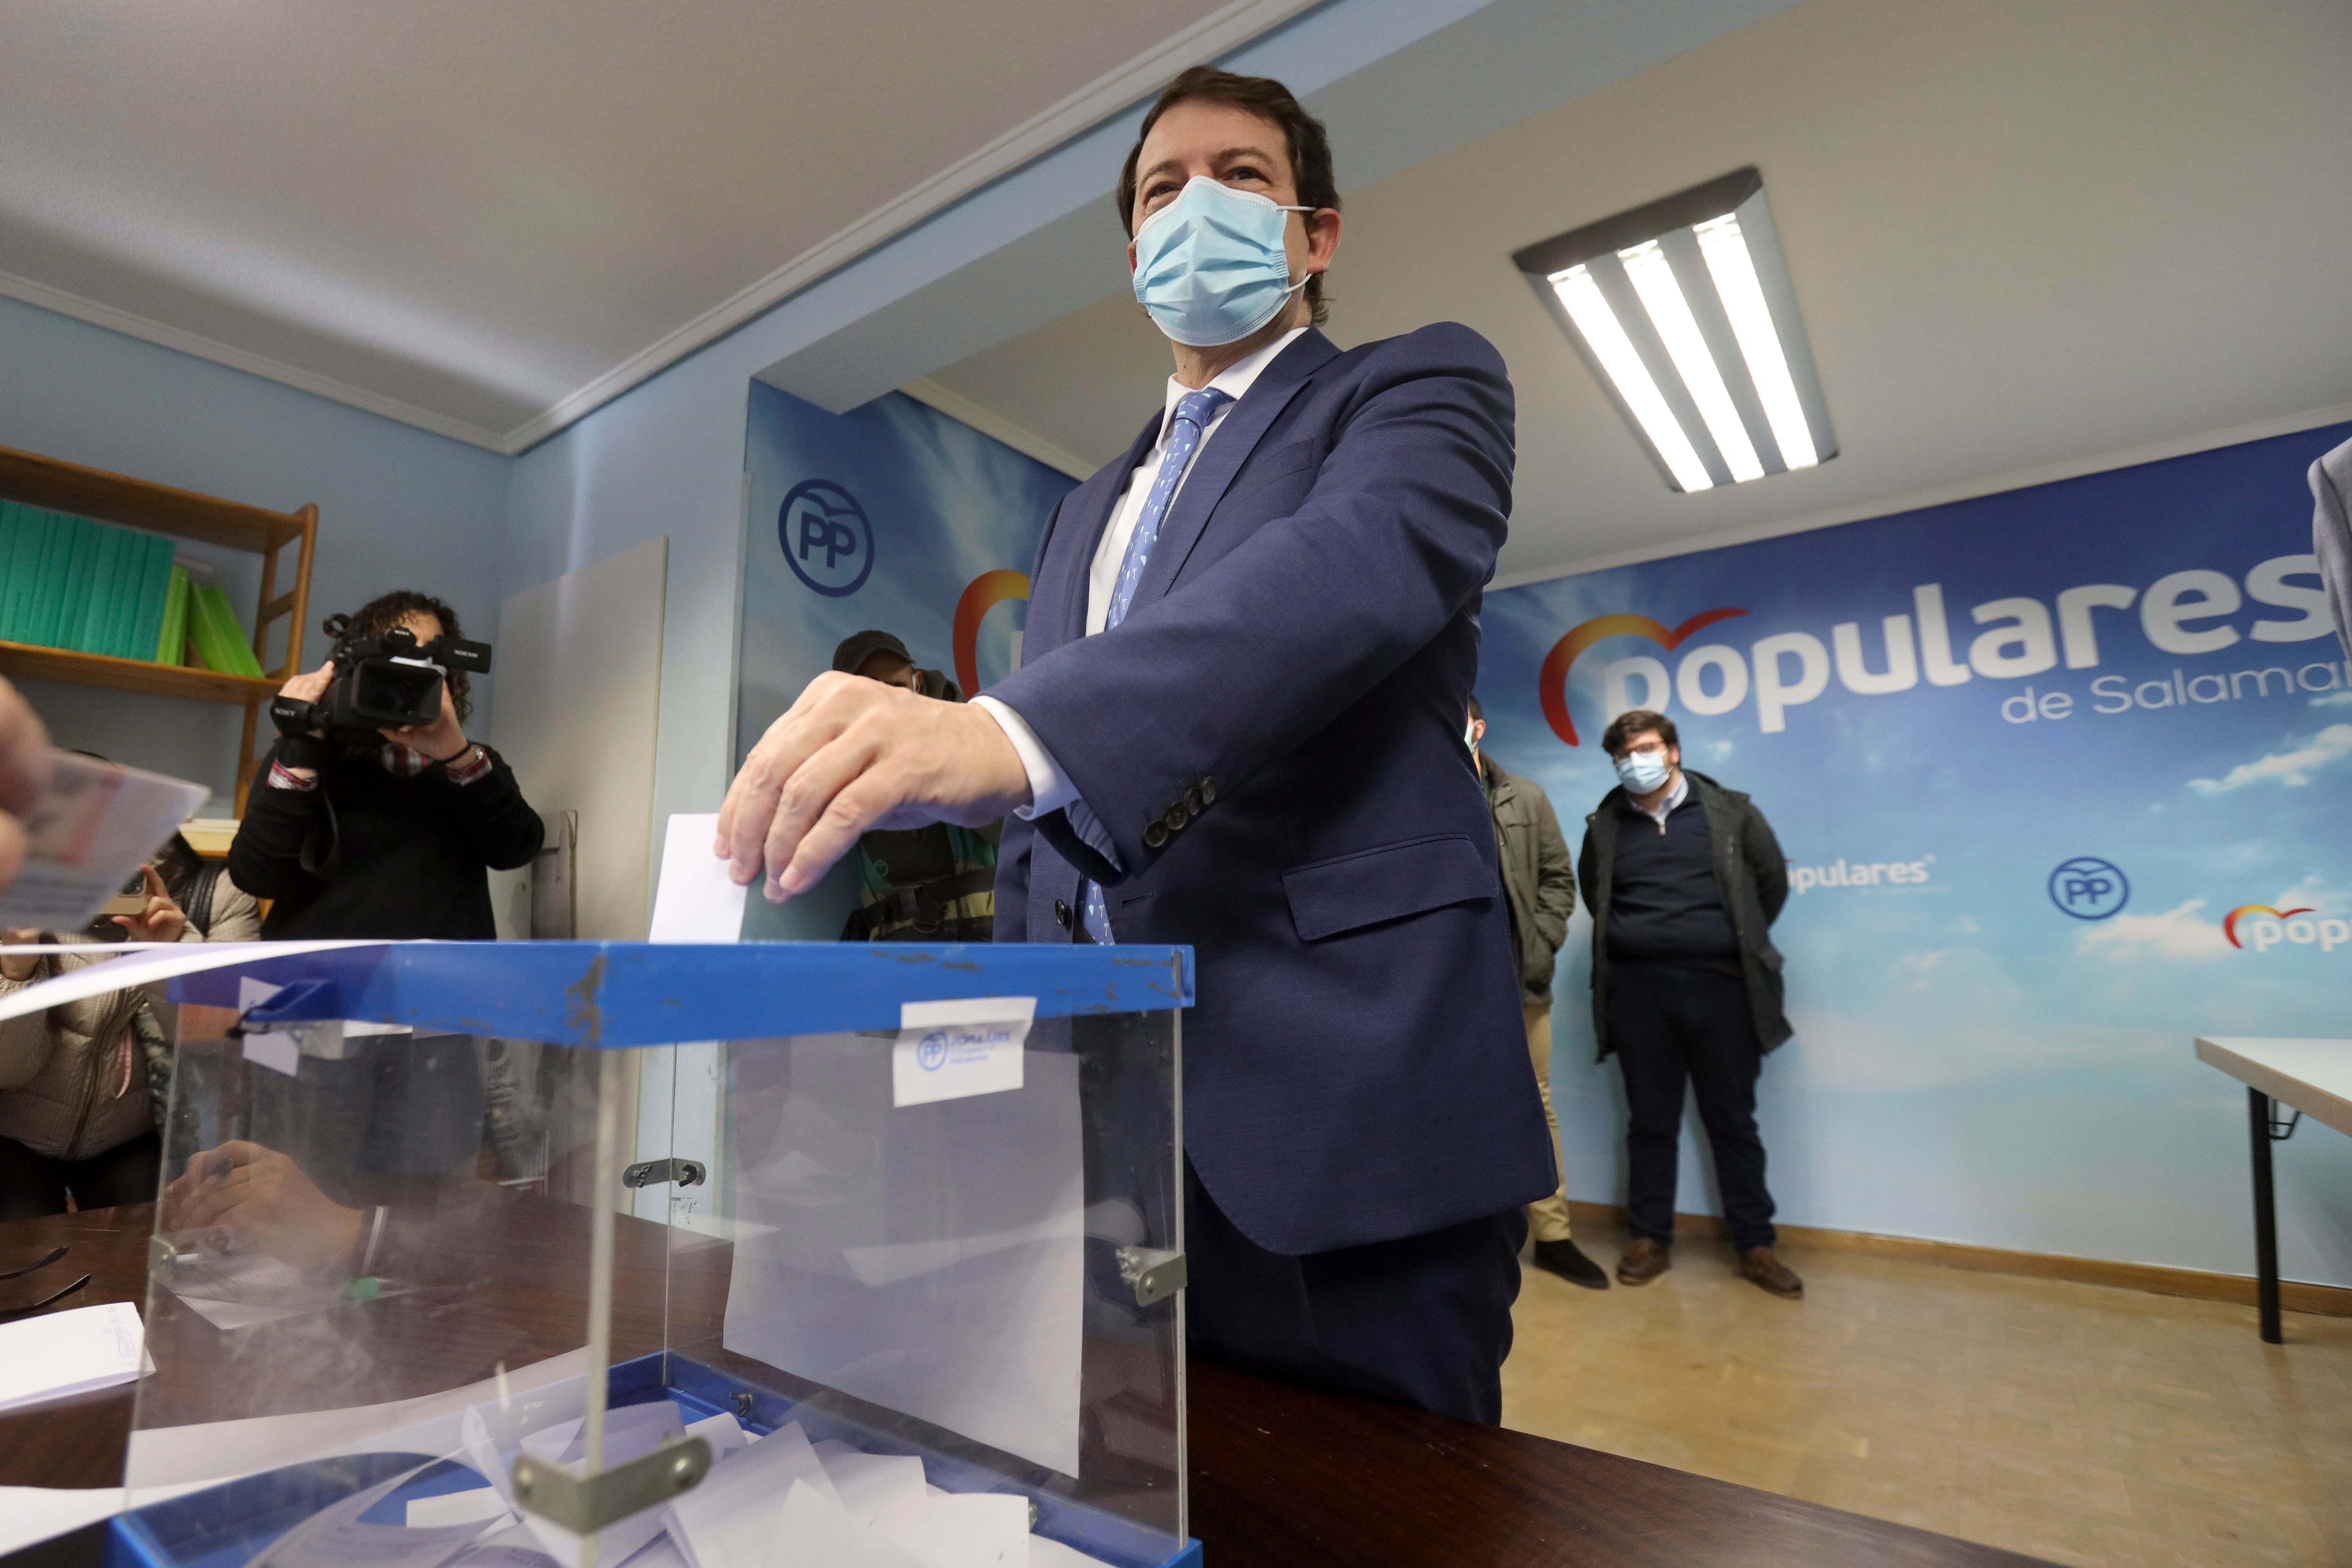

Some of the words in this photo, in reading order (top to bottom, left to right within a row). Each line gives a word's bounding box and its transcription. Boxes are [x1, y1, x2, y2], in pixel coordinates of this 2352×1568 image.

[799, 510, 857, 569] PP
[1603, 553, 2337, 735] populares
[2001, 685, 2074, 724] de
[2065, 877, 2113, 906] PP
[2251, 918, 2352, 952] pop
